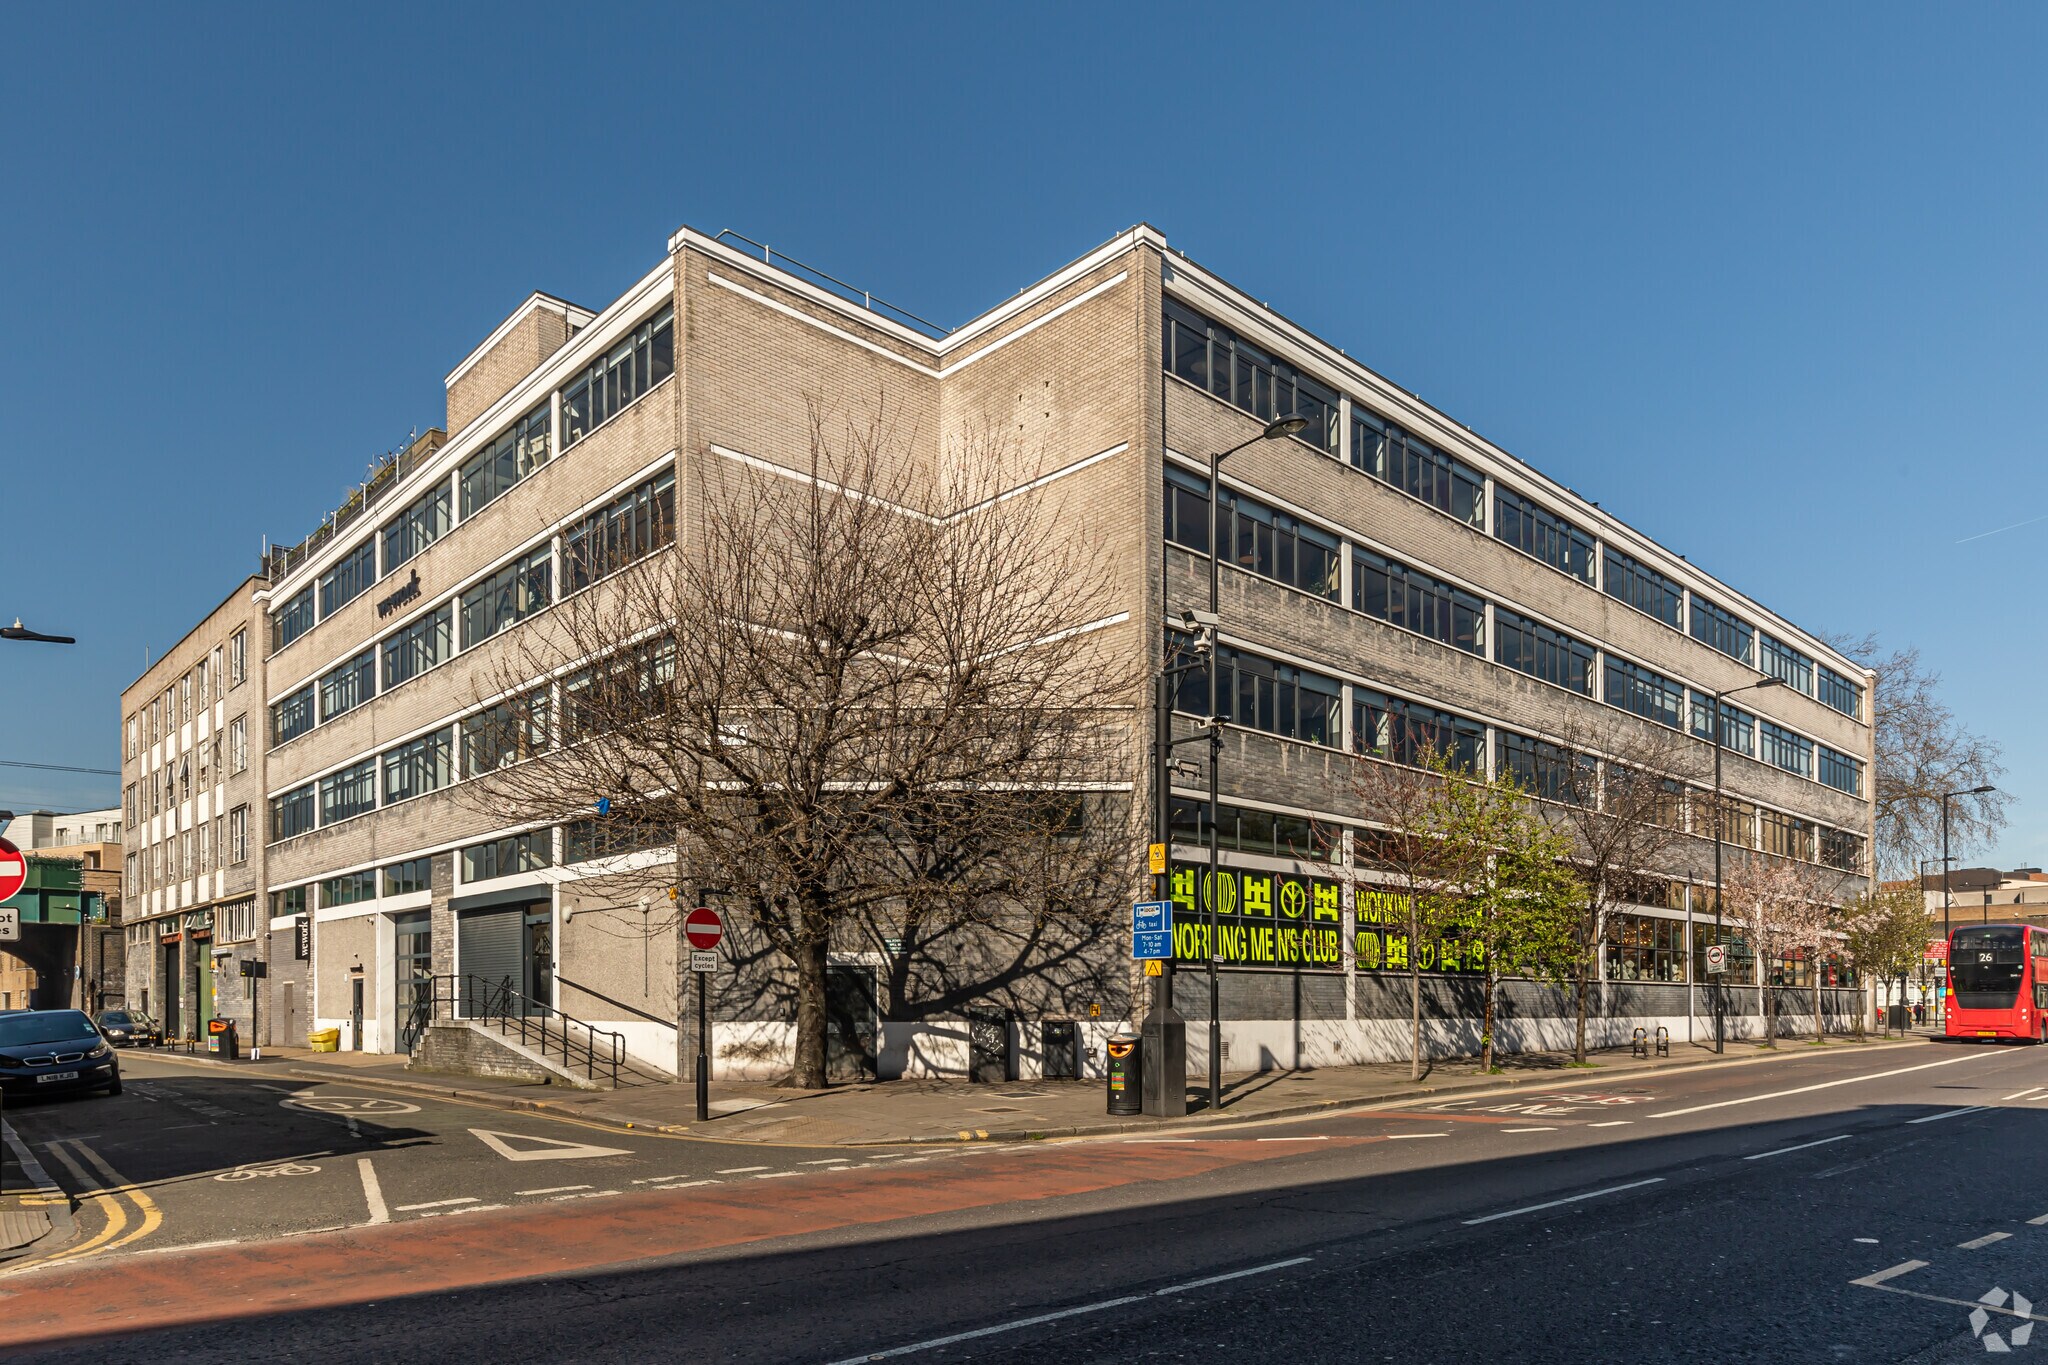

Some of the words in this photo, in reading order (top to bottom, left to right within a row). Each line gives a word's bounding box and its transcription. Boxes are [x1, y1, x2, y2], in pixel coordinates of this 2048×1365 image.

[298, 921, 308, 957] wework
[1302, 929, 1338, 963] CLUB
[1979, 952, 1993, 962] 26
